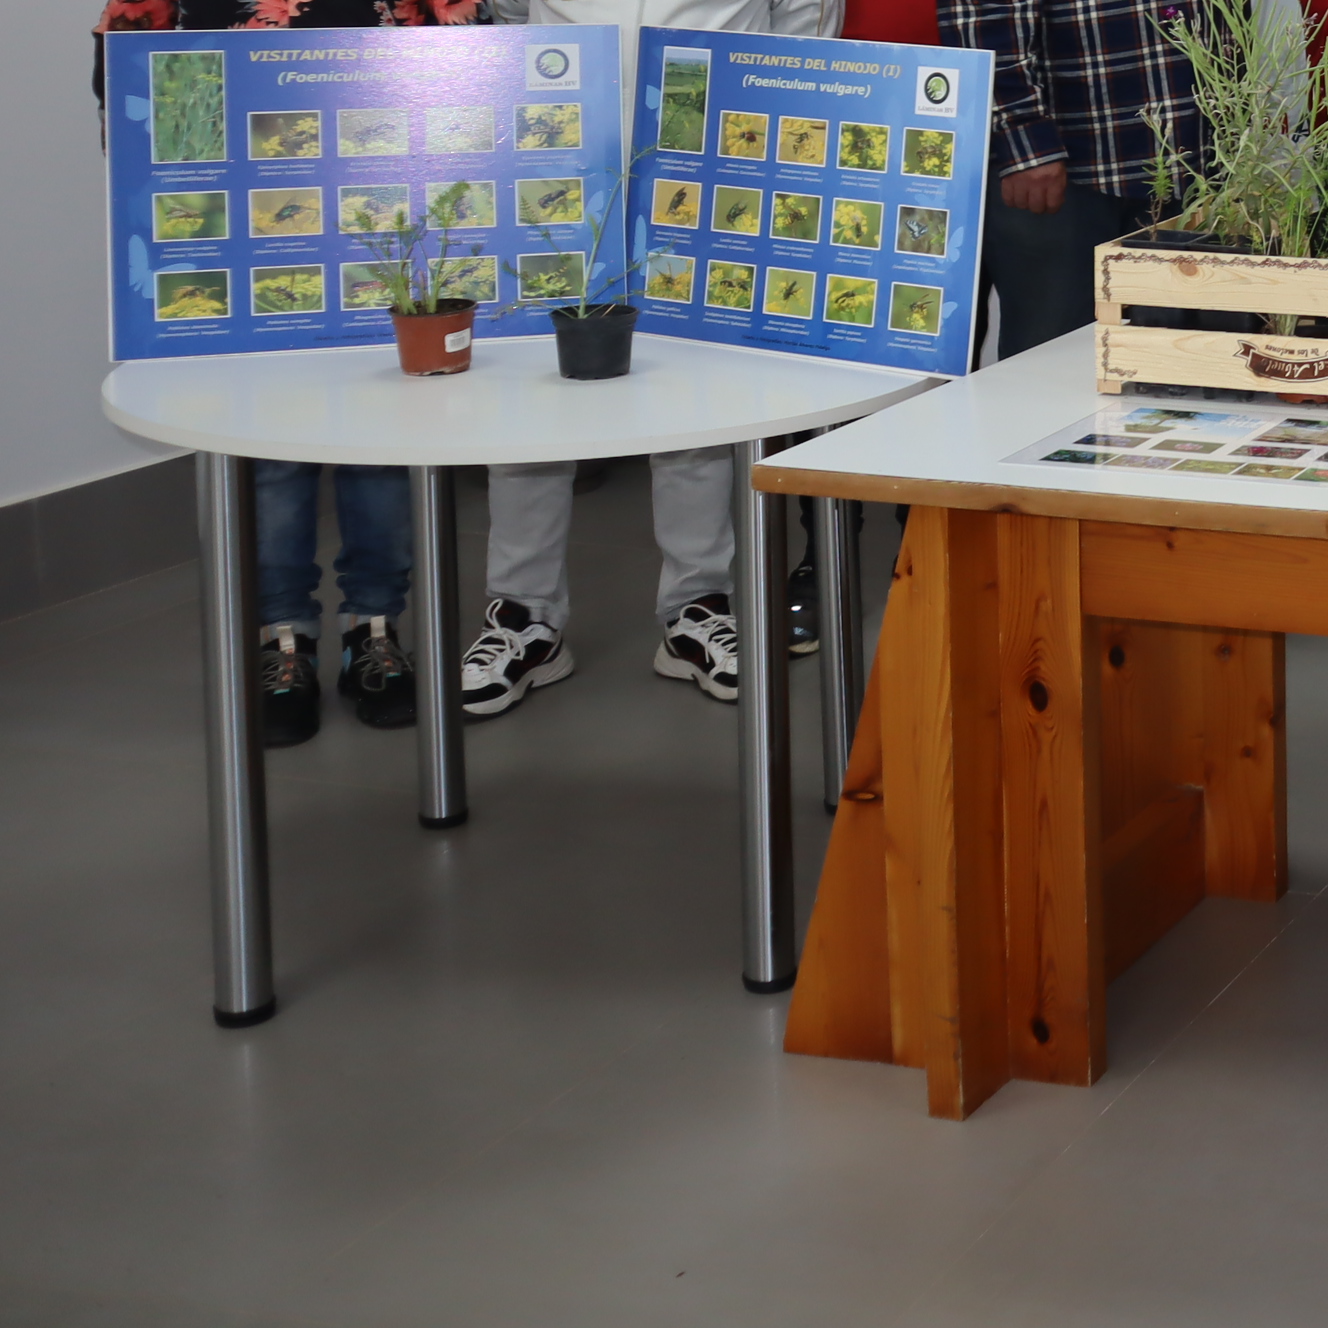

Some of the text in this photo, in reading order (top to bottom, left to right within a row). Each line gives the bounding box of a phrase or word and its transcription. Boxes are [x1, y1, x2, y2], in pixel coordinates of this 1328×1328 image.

[249, 48, 358, 62] VISITANTES
[728, 52, 901, 79] VISITANTES DEL HINOJO (I)
[742, 73, 872, 99] (Foeniculum vulgare)
